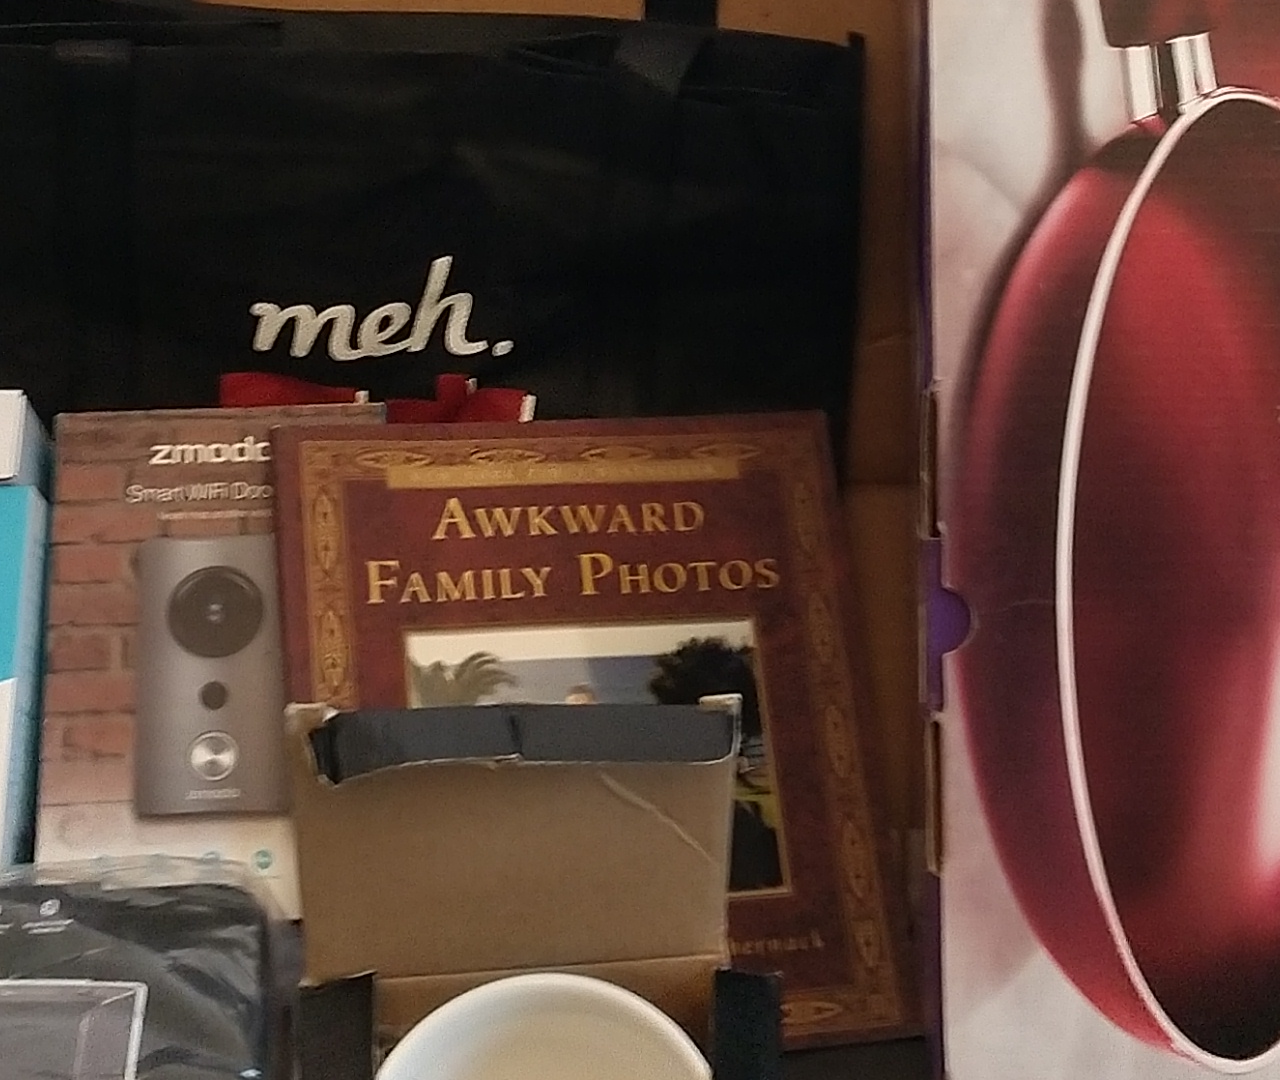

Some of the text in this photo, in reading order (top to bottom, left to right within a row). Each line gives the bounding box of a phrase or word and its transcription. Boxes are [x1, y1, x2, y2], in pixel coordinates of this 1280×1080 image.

[249, 254, 514, 361] meh.
[126, 484, 185, 503] Smart
[231, 481, 273, 500] Doo
[431, 497, 705, 541] AWKWARD
[364, 552, 781, 605] FAMILY PHOTOS
